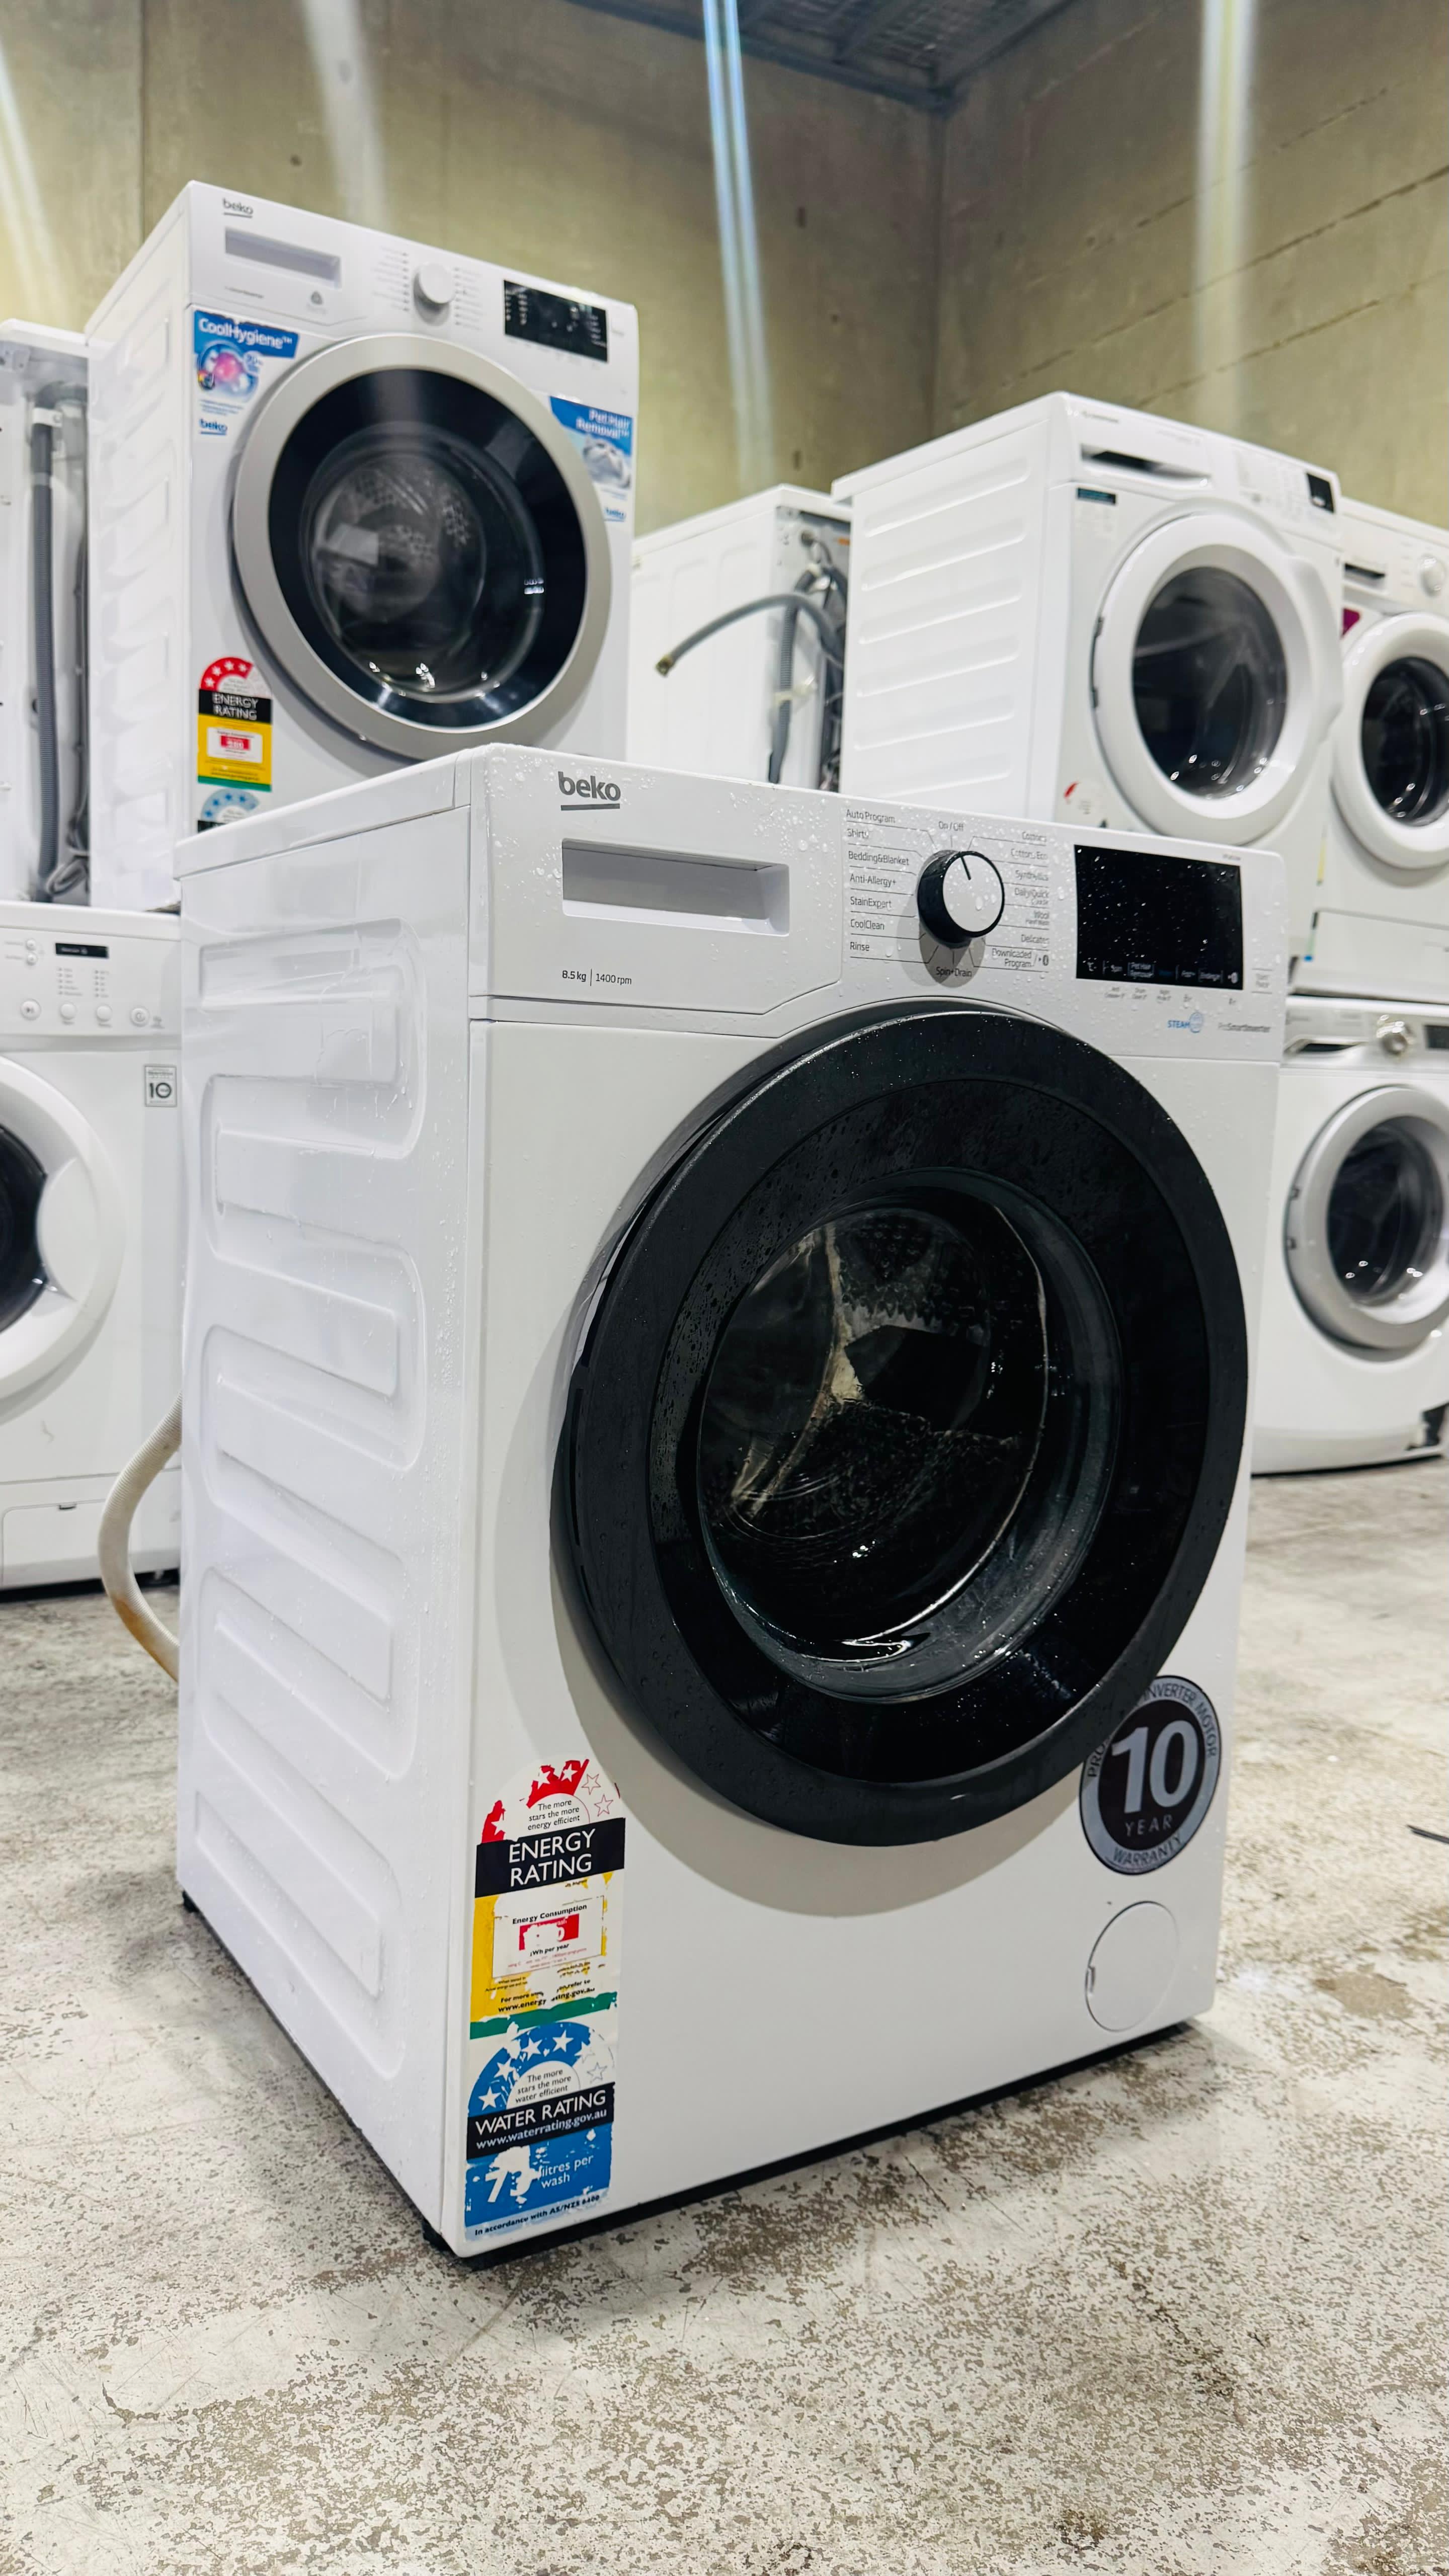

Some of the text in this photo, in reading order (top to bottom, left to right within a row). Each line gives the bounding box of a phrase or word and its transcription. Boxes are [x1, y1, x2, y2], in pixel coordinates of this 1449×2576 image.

[223, 198, 253, 215] beko
[199, 419, 228, 432] beko
[212, 692, 259, 708] ENERGY
[213, 704, 257, 720] RATING
[558, 771, 621, 801] beko
[846, 809, 896, 823] Auto Program
[848, 851, 909, 865] Bedding&Blanket
[850, 896, 892, 909] StainExpert
[850, 919, 885, 930] CoolClean
[850, 941, 870, 951] Rinse
[562, 970, 632, 985] 8.5 kg 1400 rpm
[1195, 1702, 1217, 1758] MOTOR
[1111, 1720, 1198, 1814] 10
[537, 1800, 572, 1811] The more
[528, 1815, 580, 1830] energy efficient
[529, 1807, 580, 1822] stars the more
[1124, 1814, 1172, 1837] YEAR
[509, 1828, 596, 1864] ENERGY
[1113, 1832, 1182, 1867] WARRANTY
[510, 1854, 592, 1887] RATING
[512, 1904, 587, 1925] Energy Consumption
[556, 1944, 570, 1952] year
[528, 2069, 563, 2083] The more
[518, 2075, 572, 2095] stars the more
[515, 2085, 568, 2104] water efficient
[475, 2089, 606, 2135] WATER RATING
[476, 2109, 607, 2149] www.waterrating.gov.au
[574, 2155, 594, 2171] per
[541, 2172, 571, 2189] wash
[485, 2217, 528, 2234] accordance
[530, 2210, 548, 2220] with
